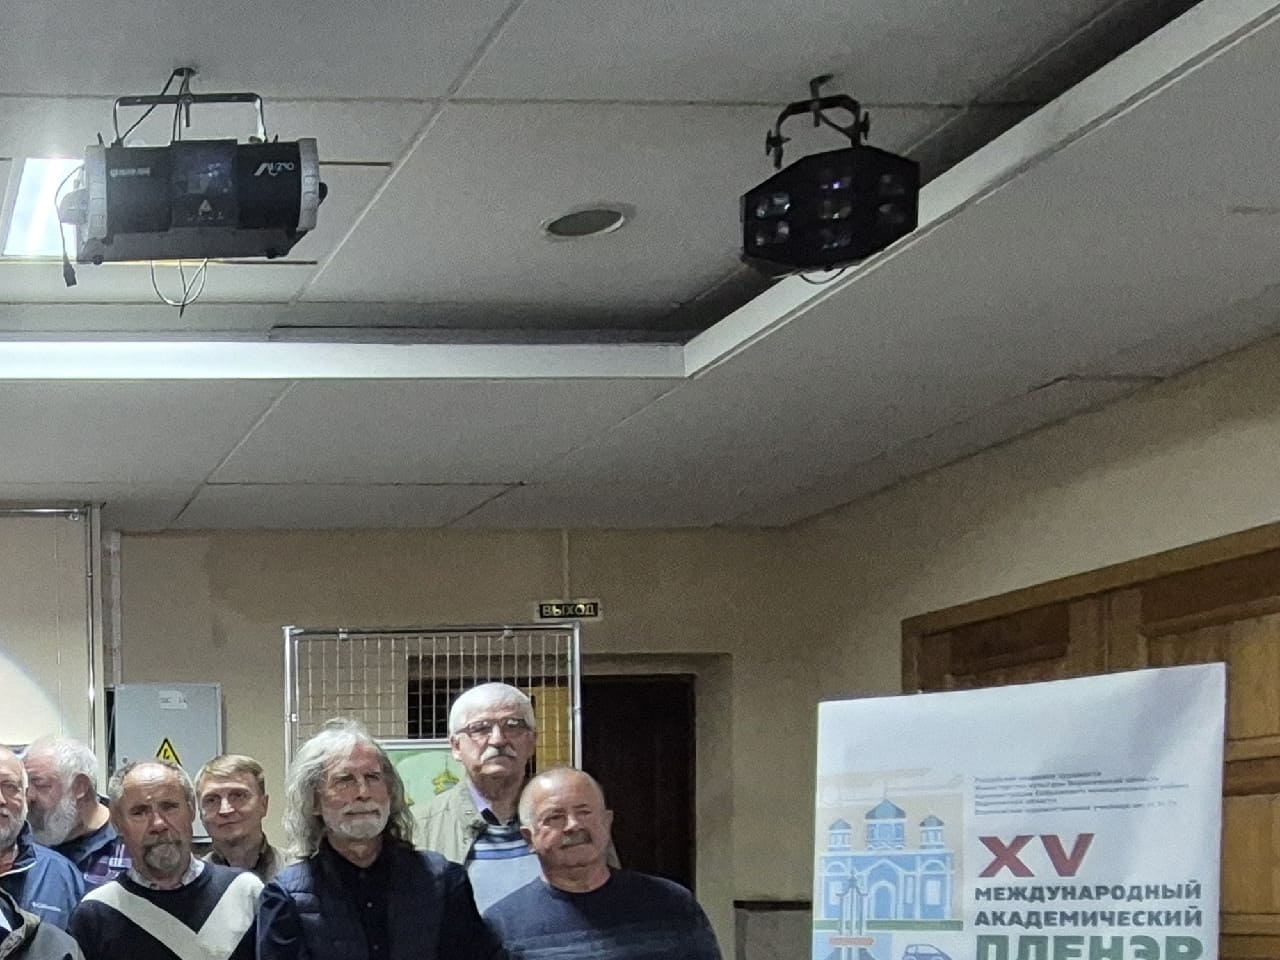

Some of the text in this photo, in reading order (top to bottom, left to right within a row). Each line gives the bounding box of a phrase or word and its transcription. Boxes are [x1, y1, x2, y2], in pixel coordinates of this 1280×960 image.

[542, 604, 596, 616] ВЫХОД
[978, 833, 1095, 878] XV
[975, 880, 1203, 903] МЕЖДУНАРОДНЫЙ
[974, 905, 1203, 929] АКАДЕМИЧЕСКИЙ
